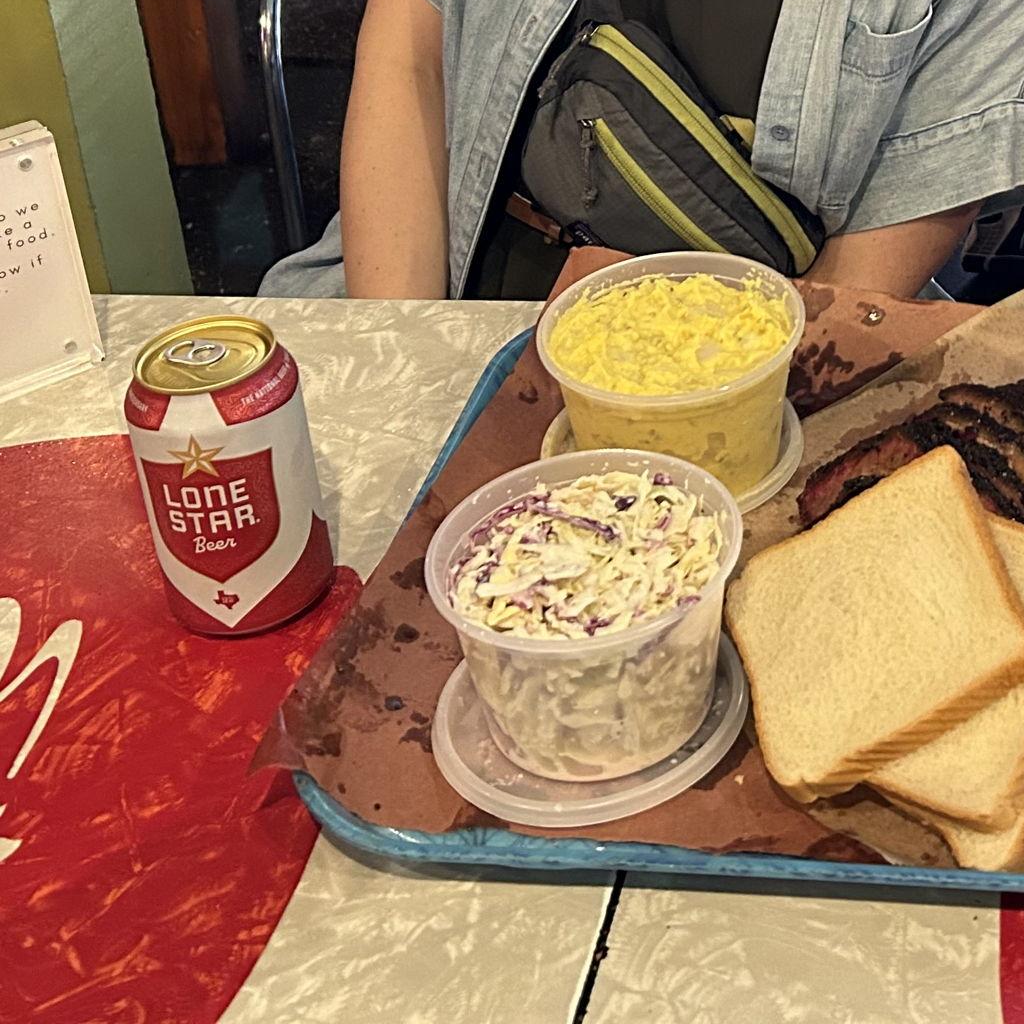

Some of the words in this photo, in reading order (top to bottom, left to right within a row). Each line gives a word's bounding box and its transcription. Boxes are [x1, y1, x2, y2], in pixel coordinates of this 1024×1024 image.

[16, 203, 38, 216] we
[23, 221, 32, 229] a
[7, 228, 55, 250] food.
[31, 254, 42, 268] if
[163, 478, 250, 509] LONE
[193, 536, 237, 554] Beer
